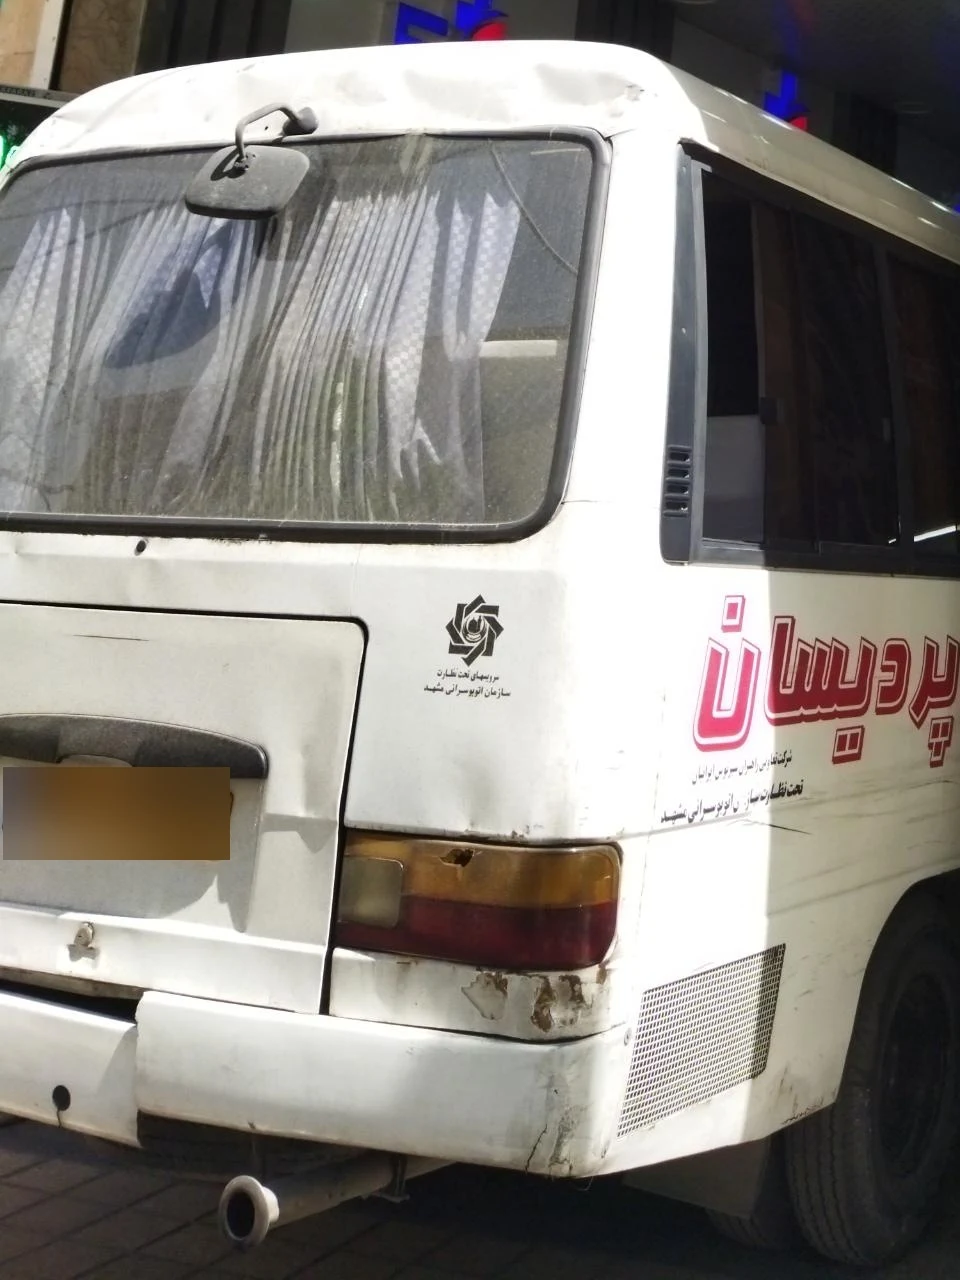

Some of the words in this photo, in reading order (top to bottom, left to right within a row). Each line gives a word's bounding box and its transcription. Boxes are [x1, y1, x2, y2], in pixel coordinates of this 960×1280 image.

[423, 682, 445, 693] مشهد
[692, 595, 960, 768] پردیسان
[484, 686, 512, 699] سازمان
